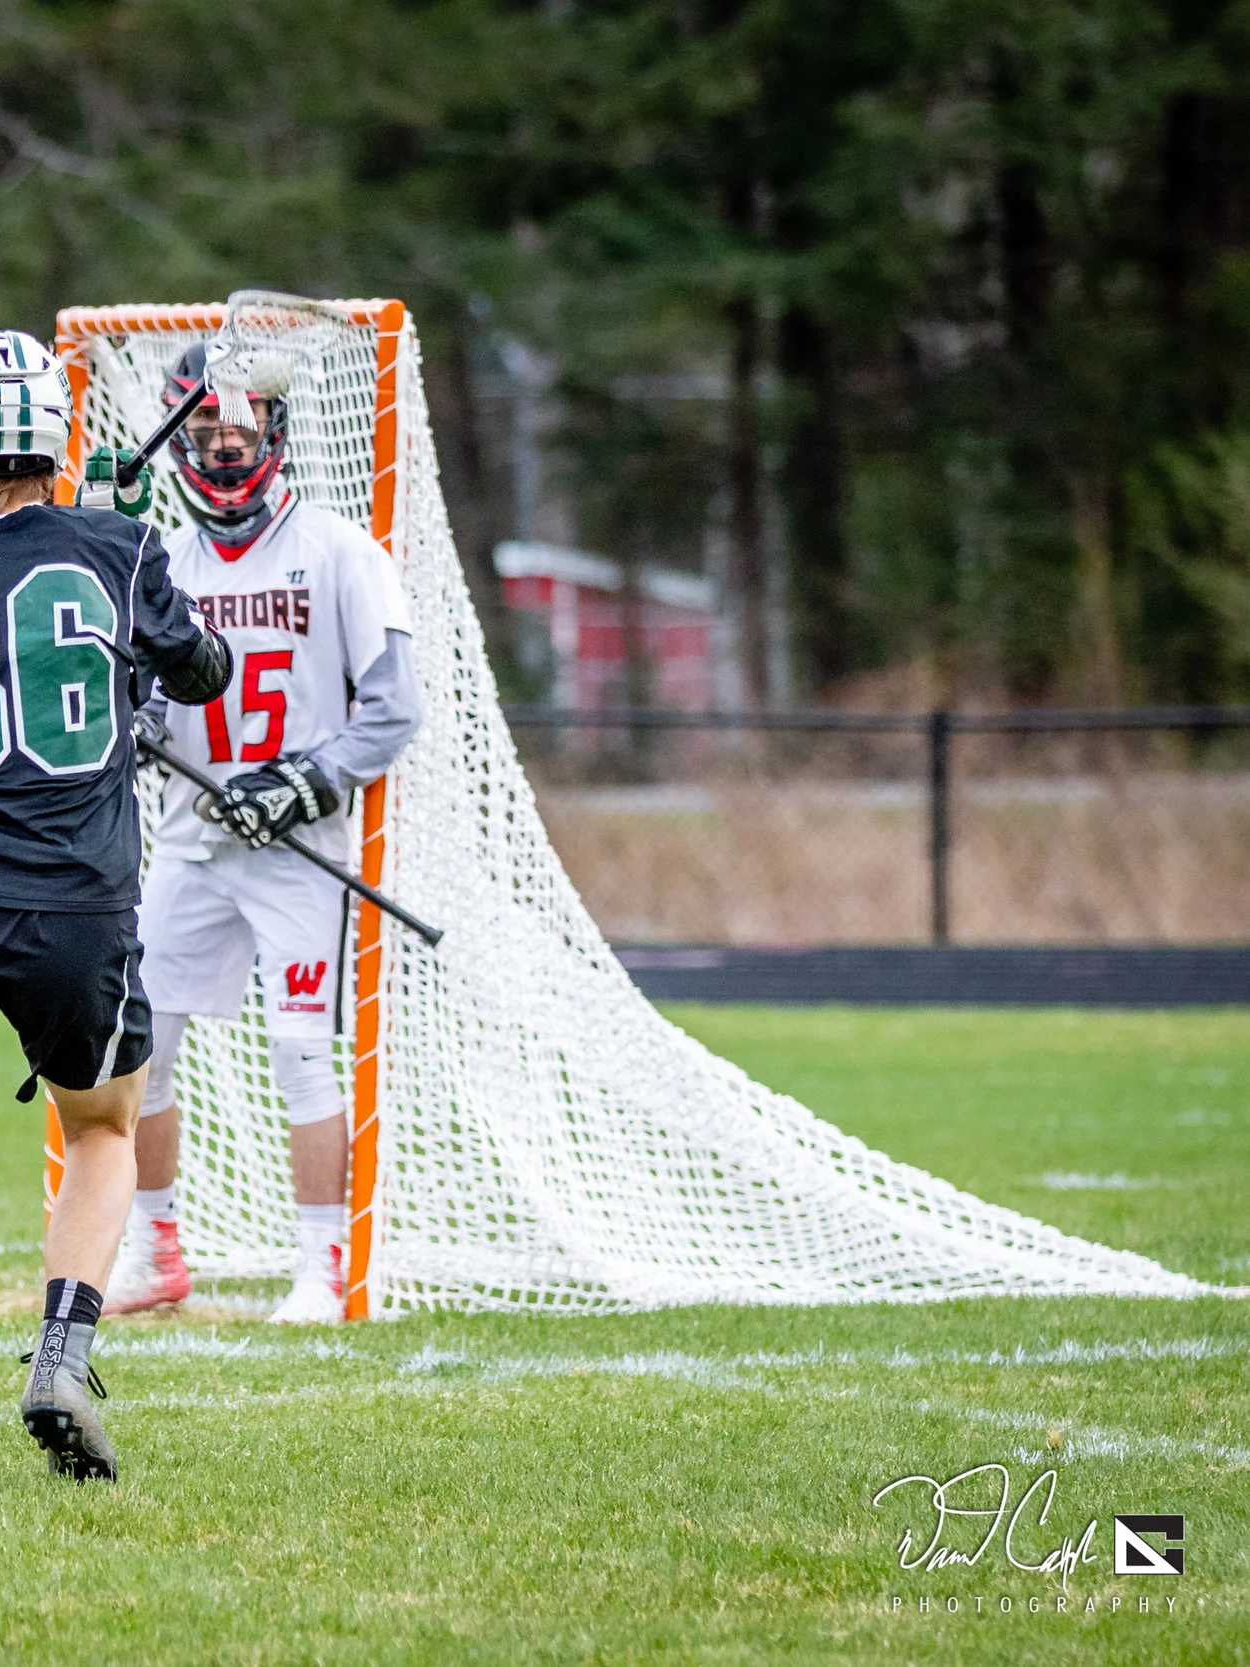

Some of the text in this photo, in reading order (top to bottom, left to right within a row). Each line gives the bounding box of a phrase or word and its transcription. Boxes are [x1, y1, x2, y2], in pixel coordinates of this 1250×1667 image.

[197, 588, 311, 637] RRIORS
[204, 649, 293, 763] 15
[285, 959, 327, 997] W
[34, 1322, 66, 1391] ARMOUR
